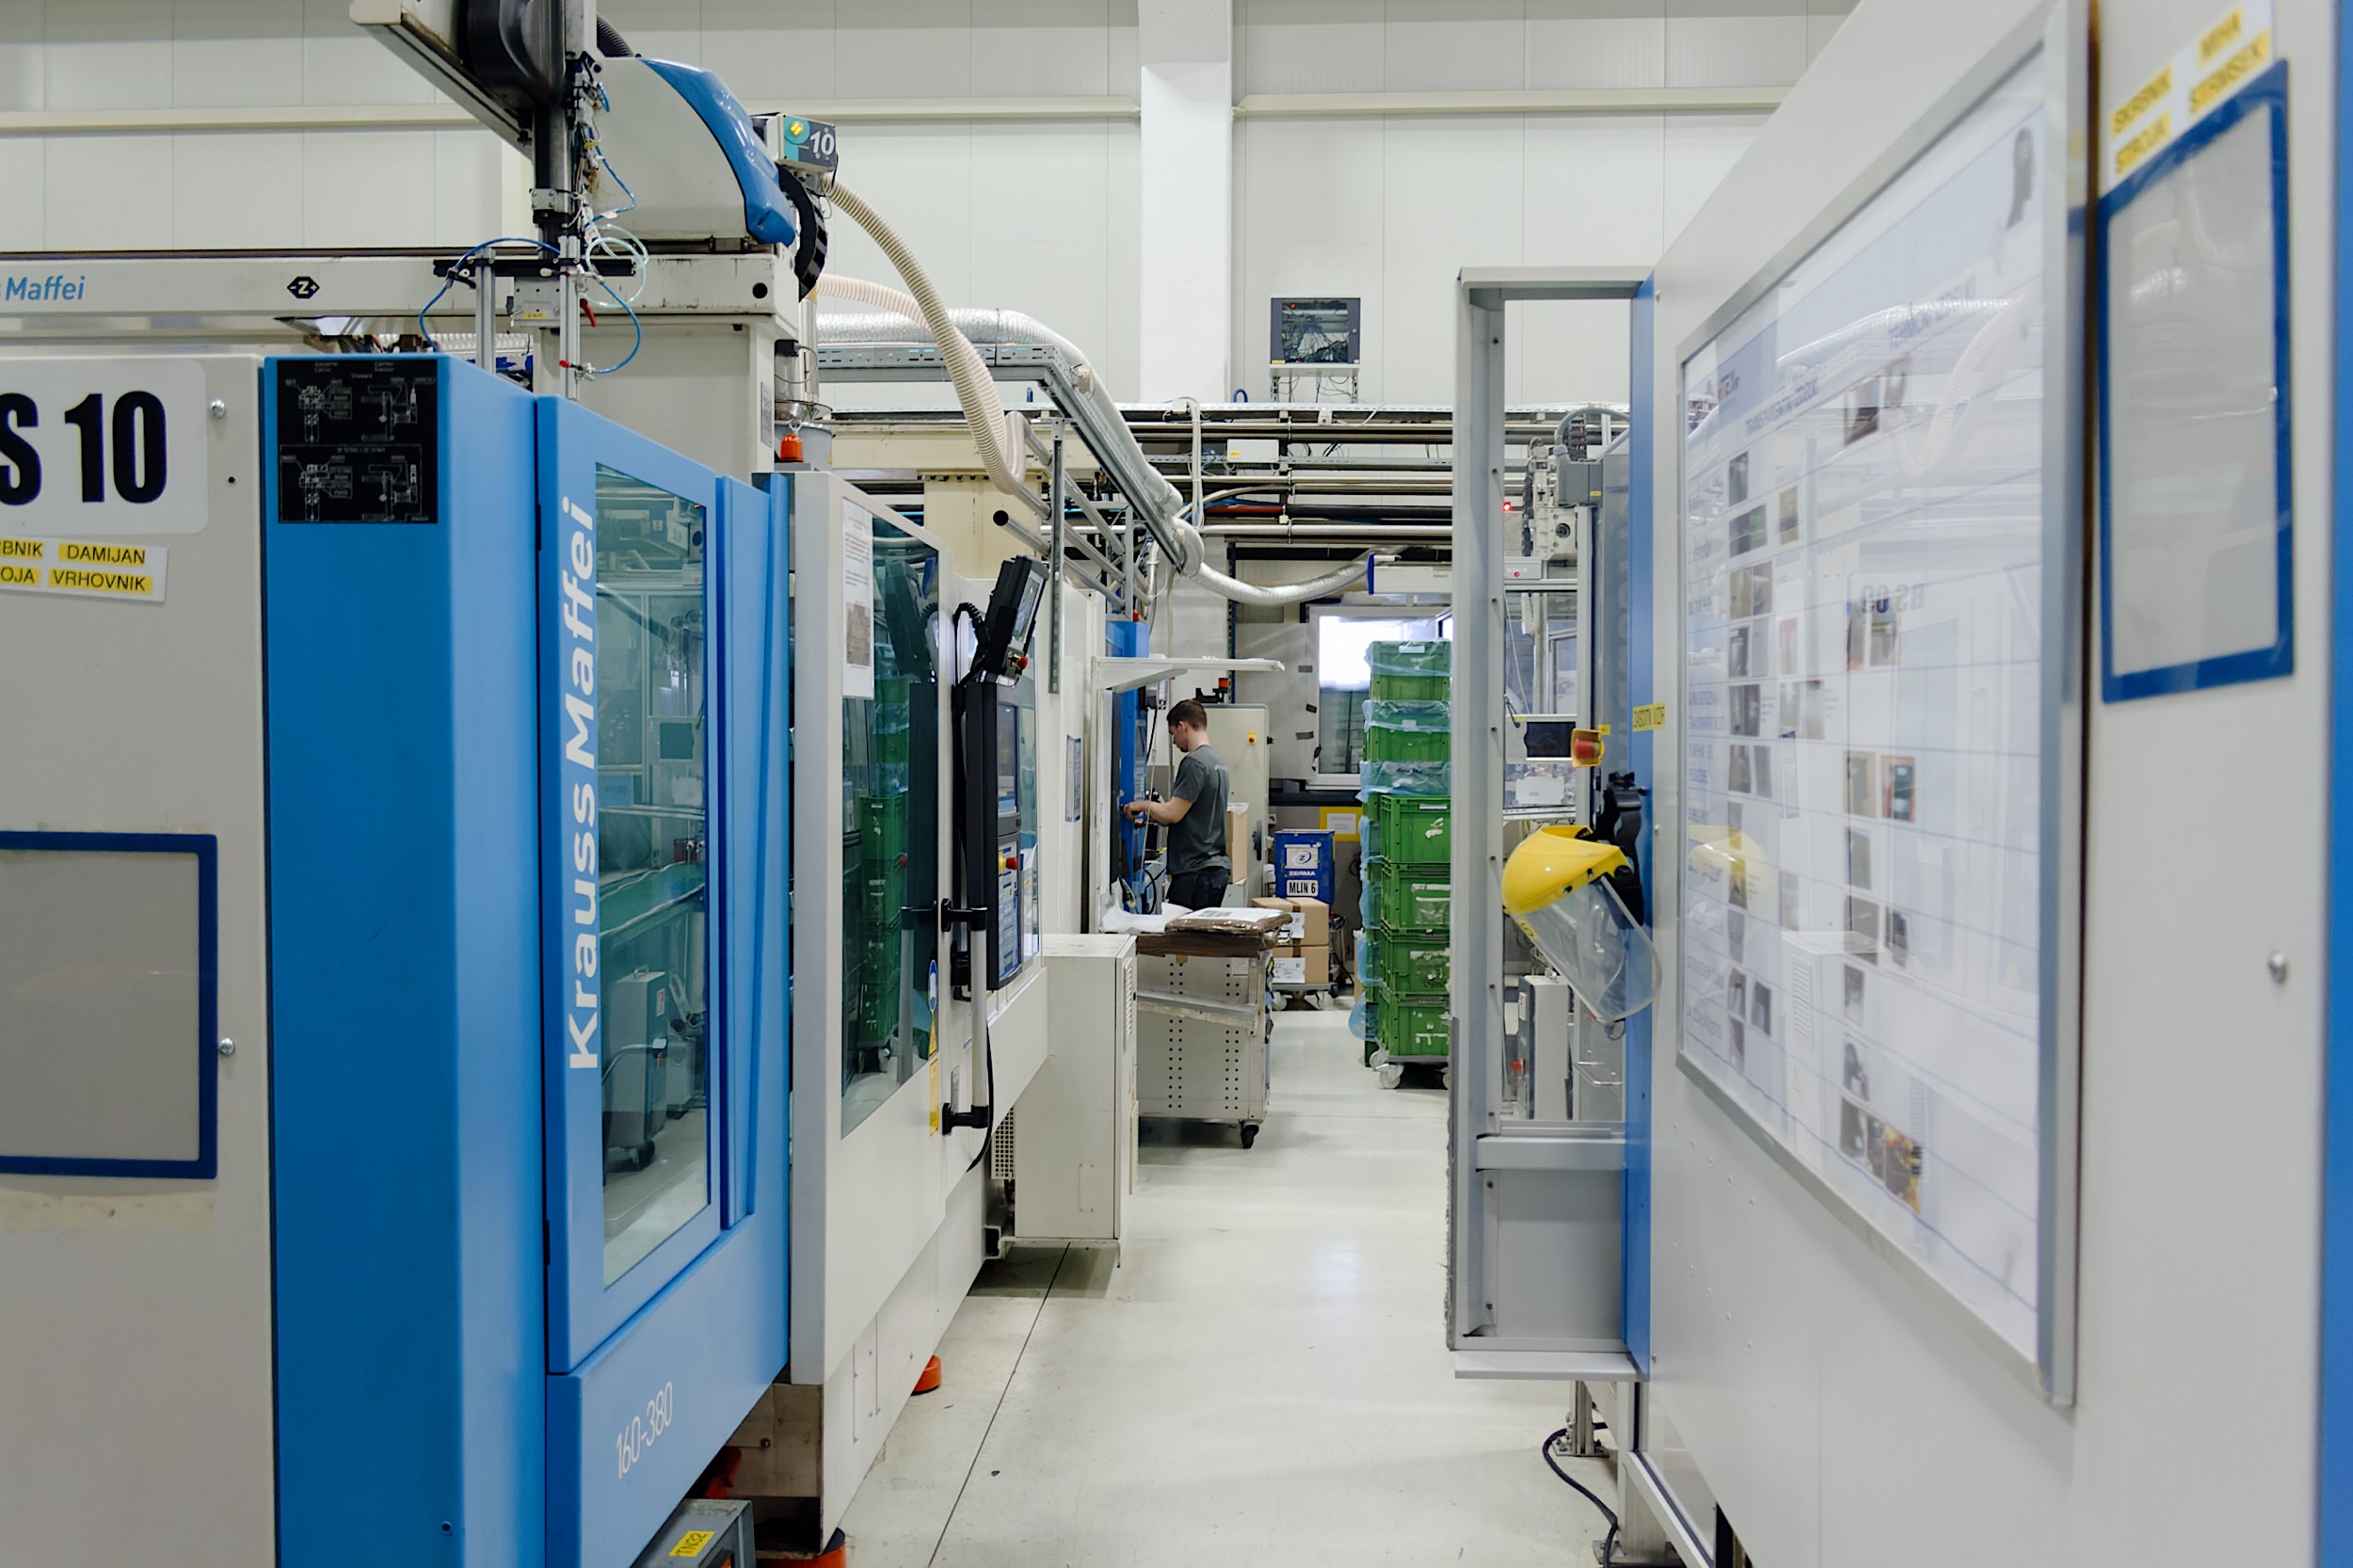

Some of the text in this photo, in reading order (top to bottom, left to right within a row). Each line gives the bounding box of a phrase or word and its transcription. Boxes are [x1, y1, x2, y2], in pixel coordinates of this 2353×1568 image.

[810, 131, 835, 155] 10
[5, 275, 86, 301] Maffei
[64, 391, 168, 504] 10
[0, 539, 146, 565] BNIK DAMIJAN
[53, 569, 146, 592] VRHOVNIK
[562, 496, 600, 1069] Krauss Maffei
[1289, 882, 1316, 894] MLIN 6
[616, 1381, 673, 1480] 160-380
